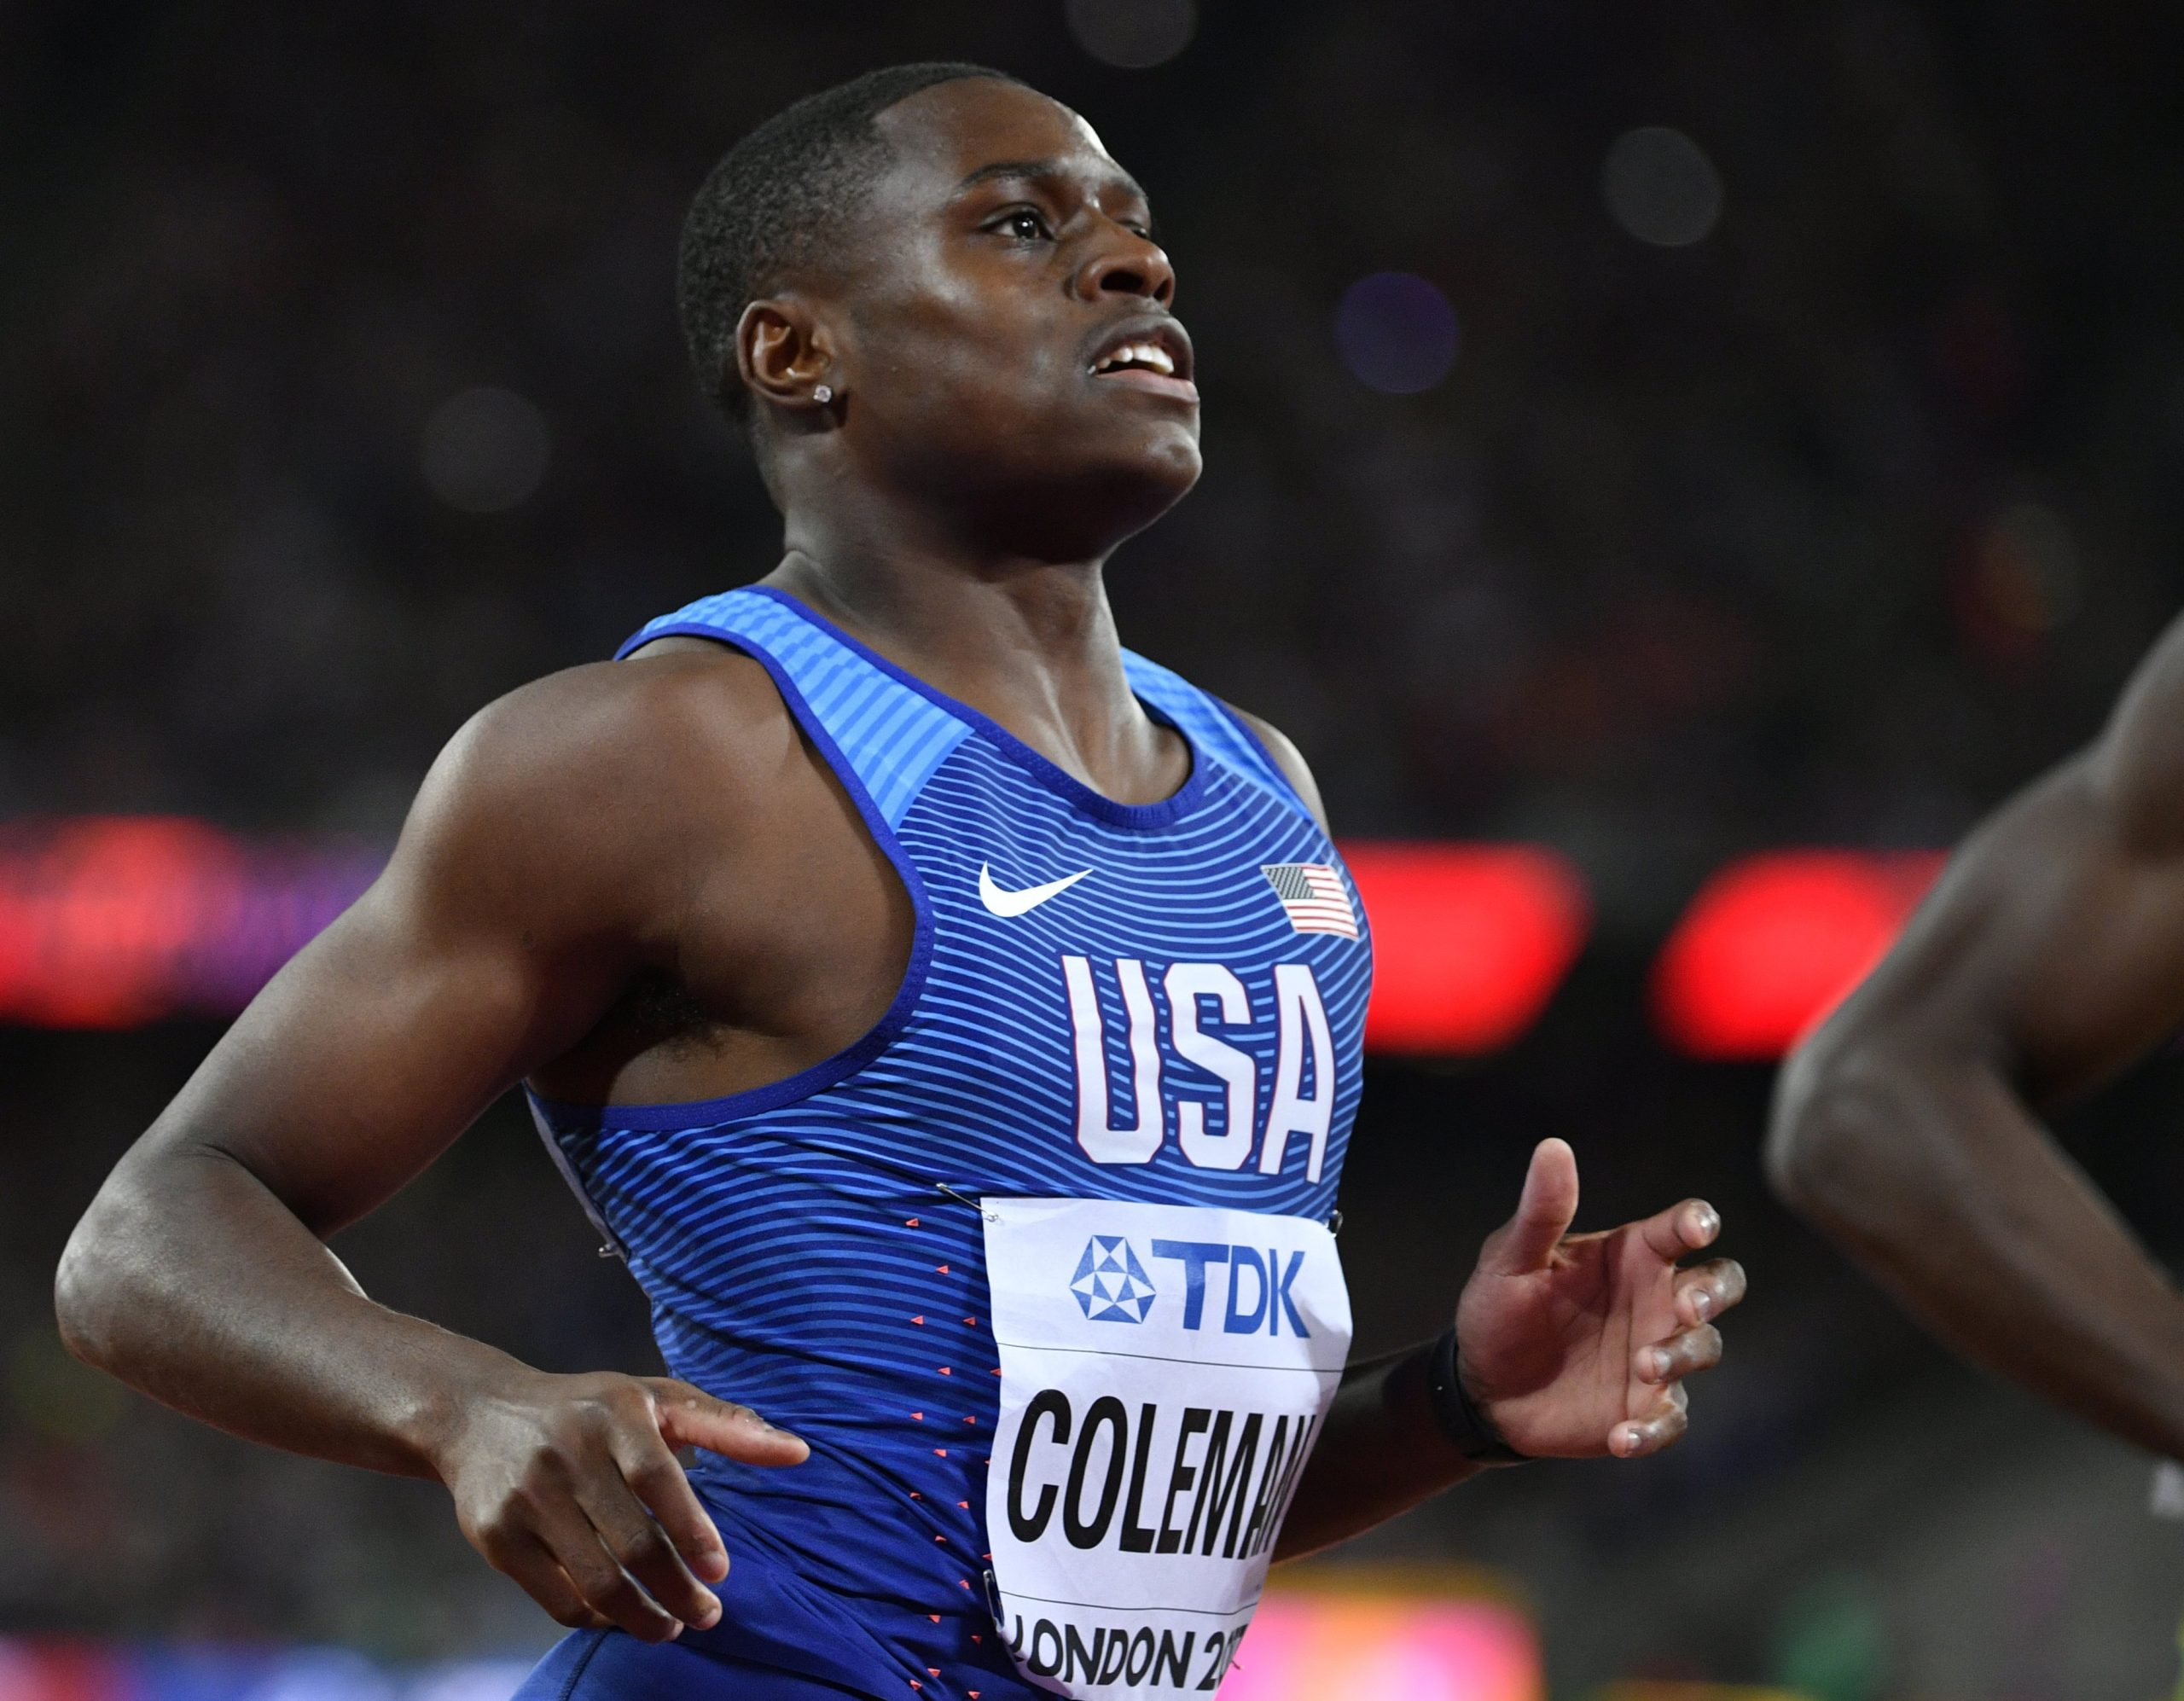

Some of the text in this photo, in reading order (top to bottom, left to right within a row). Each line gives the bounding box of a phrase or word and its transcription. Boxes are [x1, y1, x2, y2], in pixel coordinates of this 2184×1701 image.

[1061, 954, 1336, 1185] USA
[1150, 1239, 1311, 1338] TDK
[1006, 1388, 1317, 1561] COLEMAN
